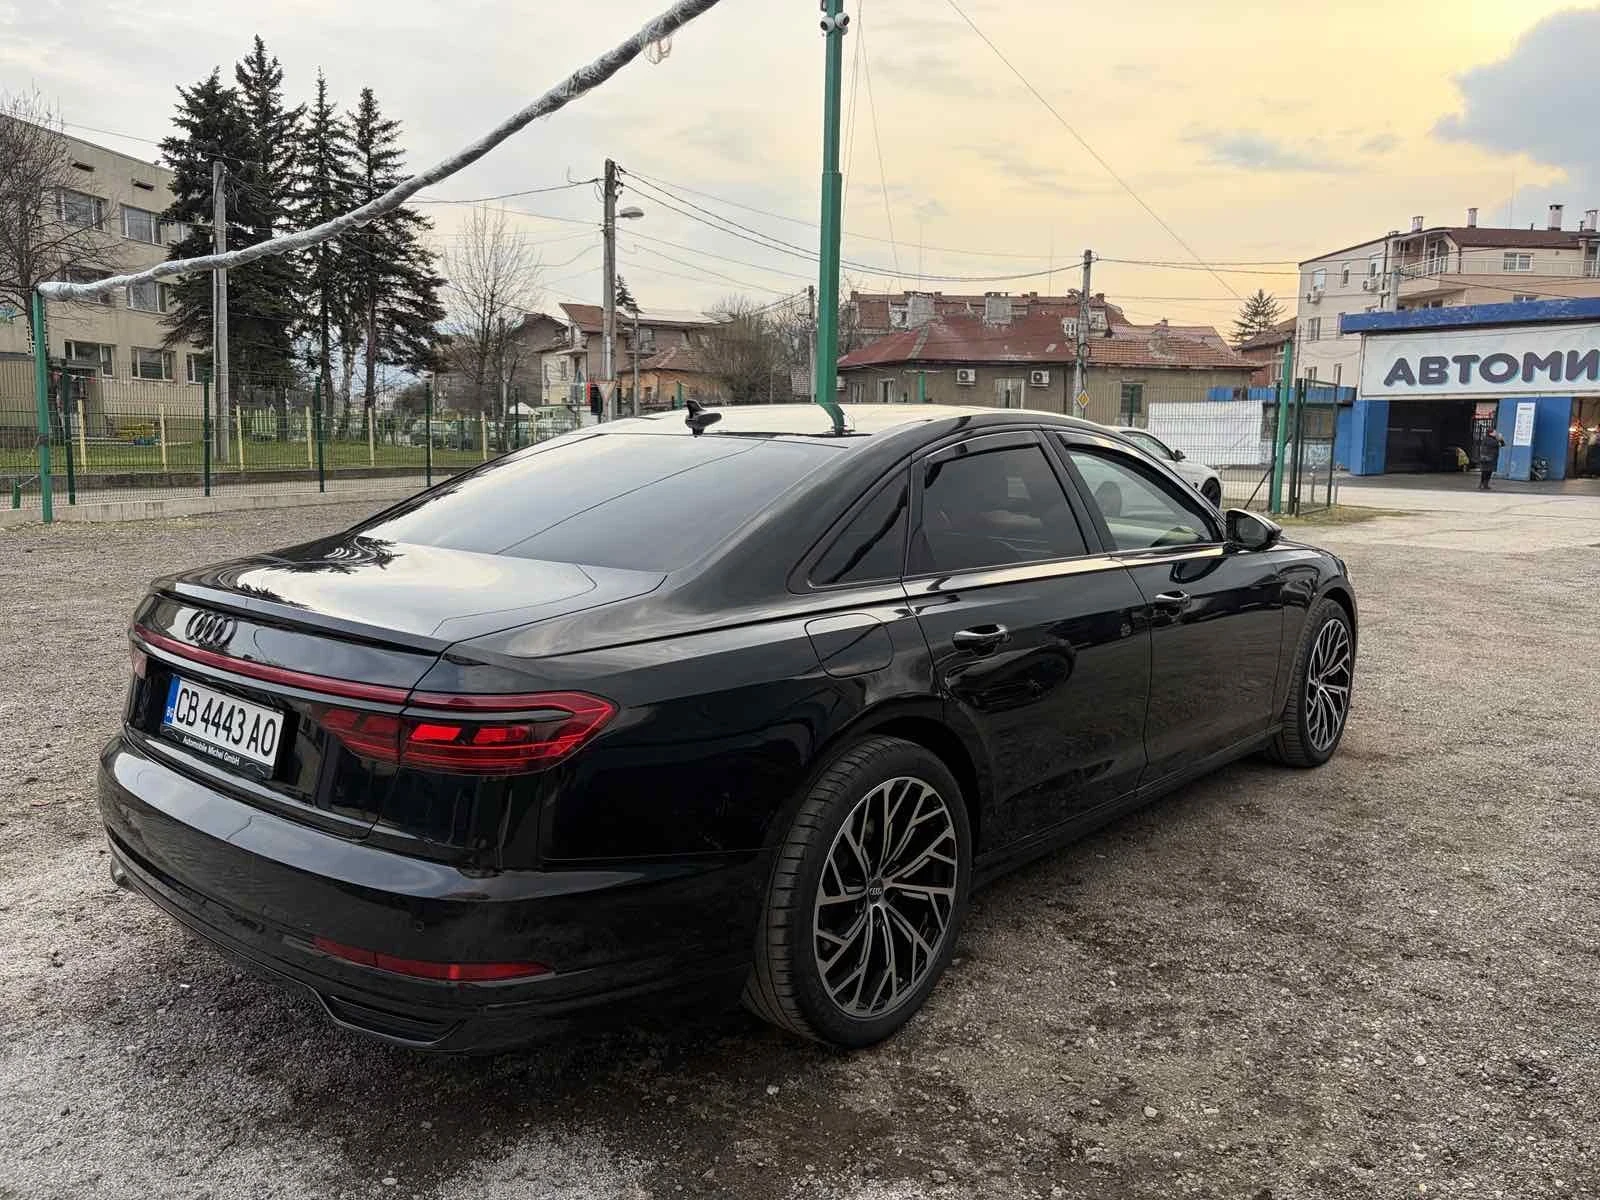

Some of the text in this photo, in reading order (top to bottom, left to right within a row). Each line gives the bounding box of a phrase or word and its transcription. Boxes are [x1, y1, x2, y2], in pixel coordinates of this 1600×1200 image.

[1383, 349, 1599, 386] АВТОМИ
[176, 687, 276, 757] CB 4443 AO
[223, 751, 240, 766] GmbH
